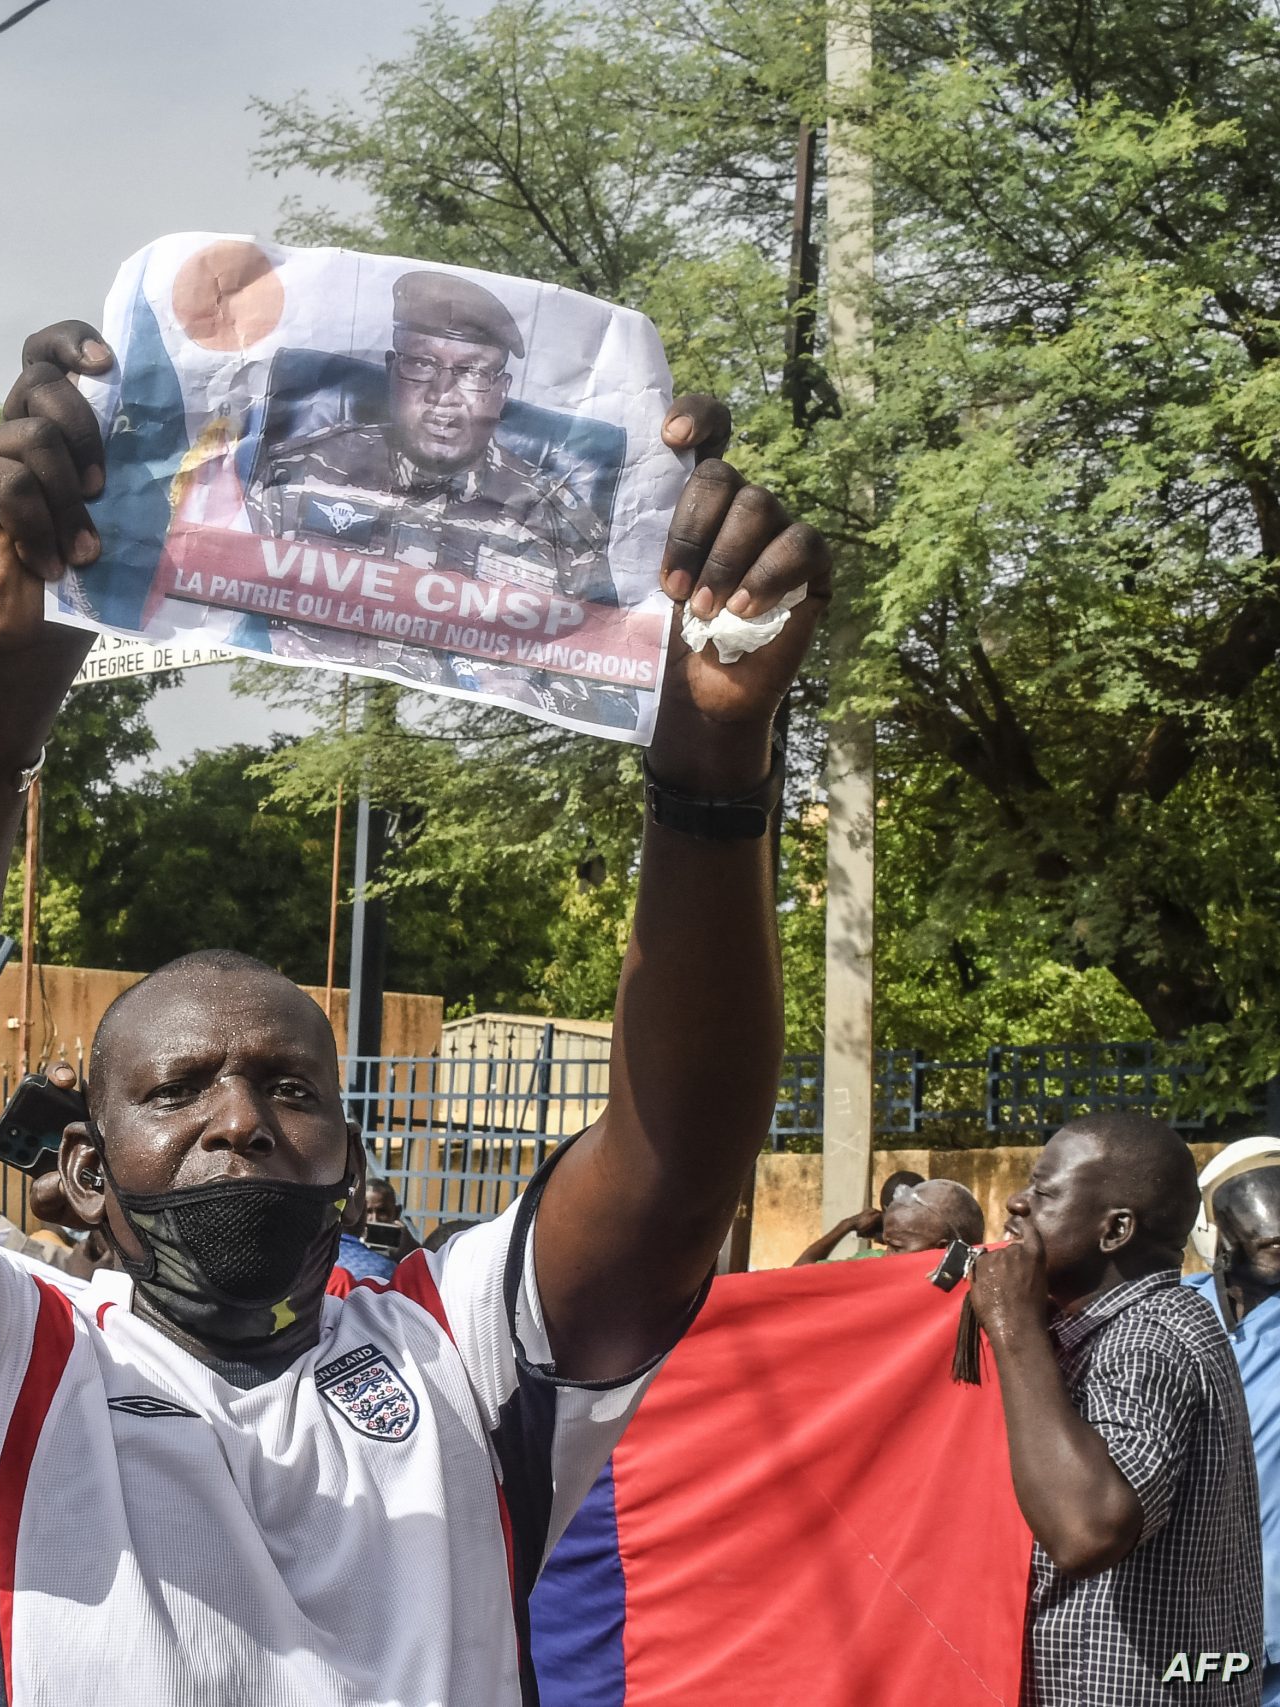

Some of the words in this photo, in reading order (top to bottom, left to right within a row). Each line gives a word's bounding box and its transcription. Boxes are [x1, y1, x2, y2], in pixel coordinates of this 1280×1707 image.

[261, 540, 399, 601] VIVE
[415, 574, 586, 636] CNSP
[174, 568, 203, 594] LA
[209, 575, 294, 612] PATRIE
[297, 594, 332, 620] OU
[337, 603, 365, 627] LA
[371, 609, 443, 642] MORT
[444, 624, 511, 656] NOUS
[516, 638, 654, 682] VAINCRONS
[76, 652, 145, 680] NTEGREE
[154, 648, 173, 669] DE
[314, 1348, 373, 1383] ENGLAND
